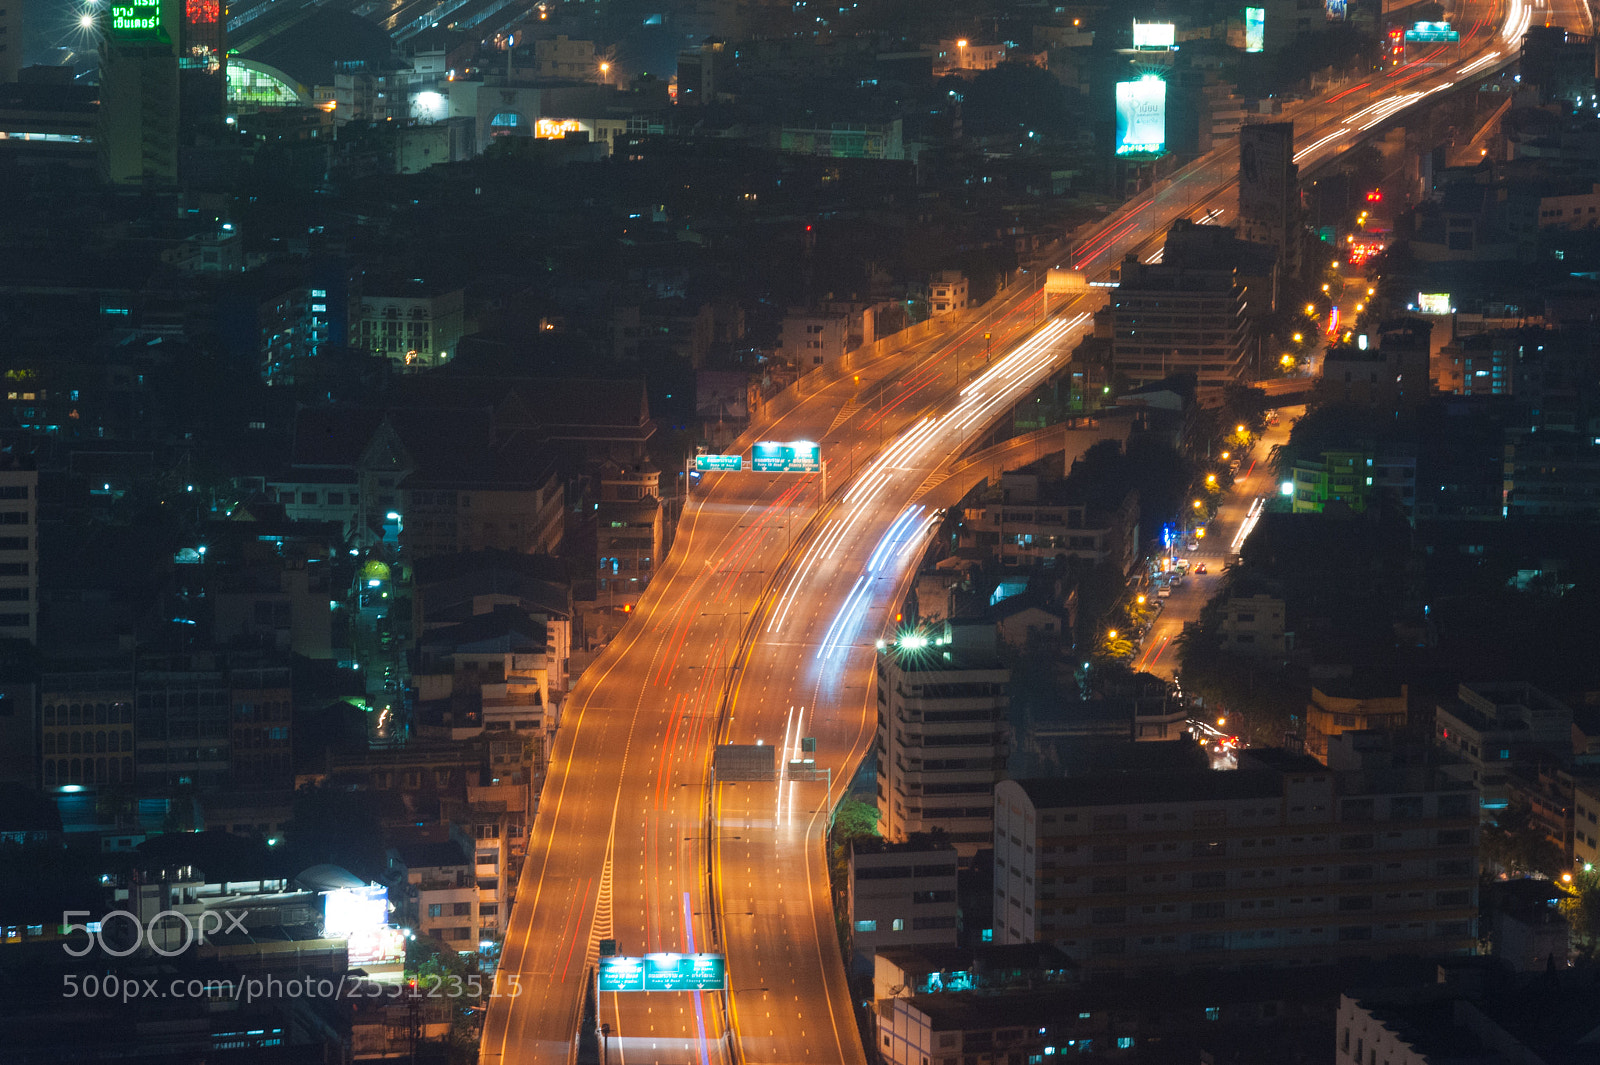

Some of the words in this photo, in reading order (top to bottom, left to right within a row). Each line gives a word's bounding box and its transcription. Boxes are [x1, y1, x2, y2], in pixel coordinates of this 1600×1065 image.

[113, 7, 134, 17] บาง
[113, 16, 156, 29] เซ็นเตอร์
